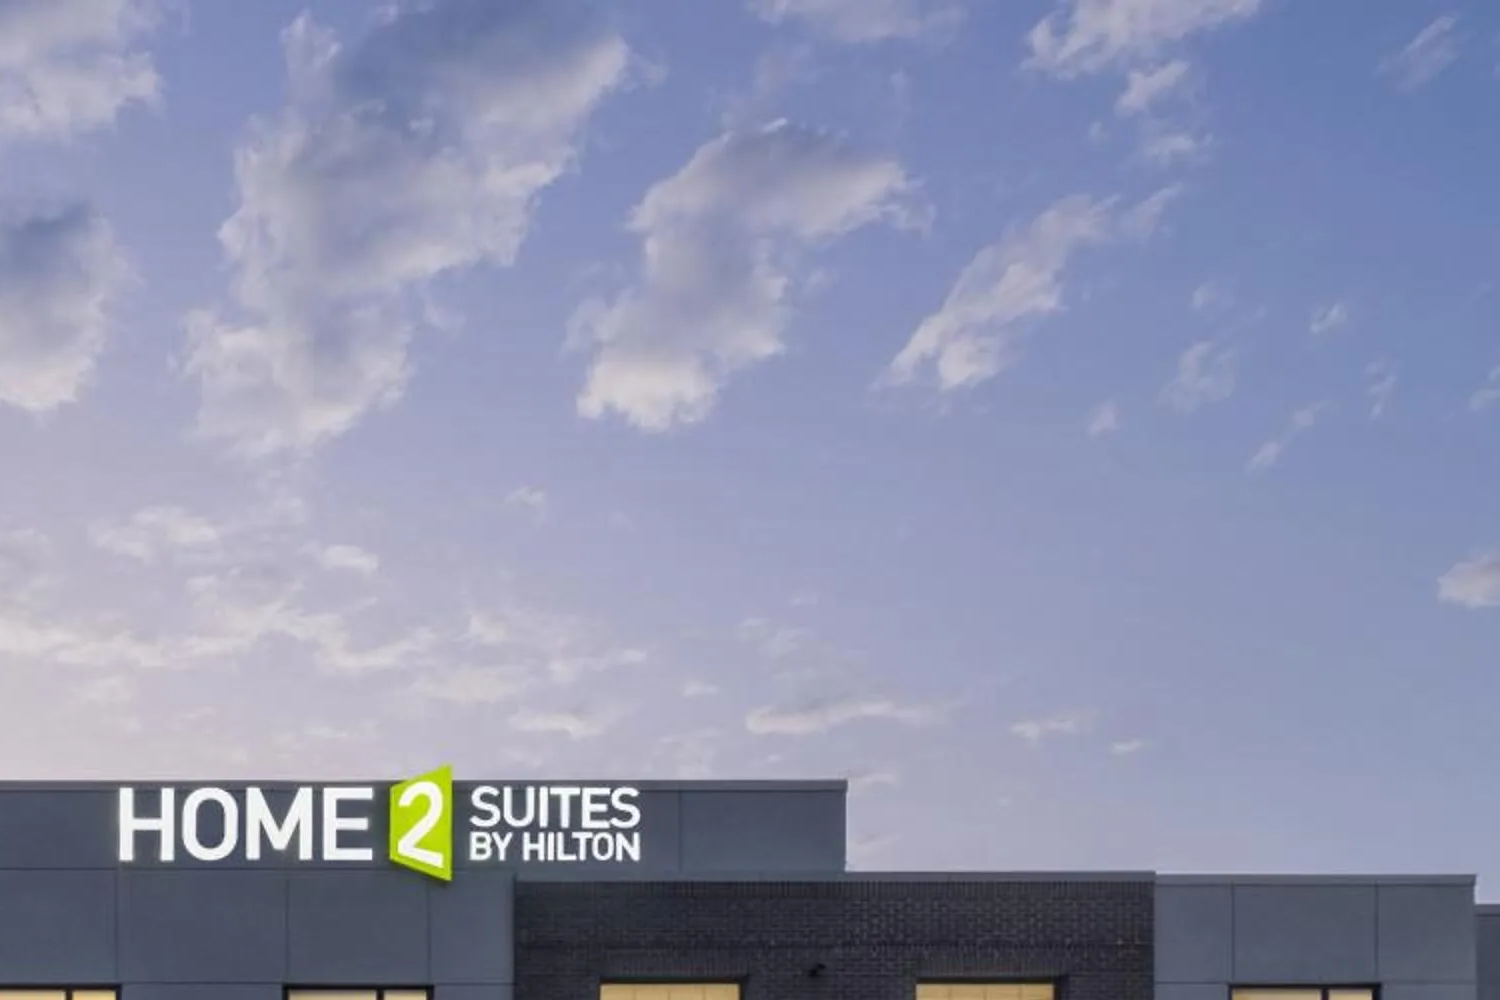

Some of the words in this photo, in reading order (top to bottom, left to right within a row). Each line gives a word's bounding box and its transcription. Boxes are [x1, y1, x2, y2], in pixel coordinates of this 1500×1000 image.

[118, 787, 373, 861] HOME
[397, 780, 445, 869] 2
[469, 786, 641, 828] SUITES
[469, 832, 513, 861] BY
[523, 832, 641, 861] HILTON
